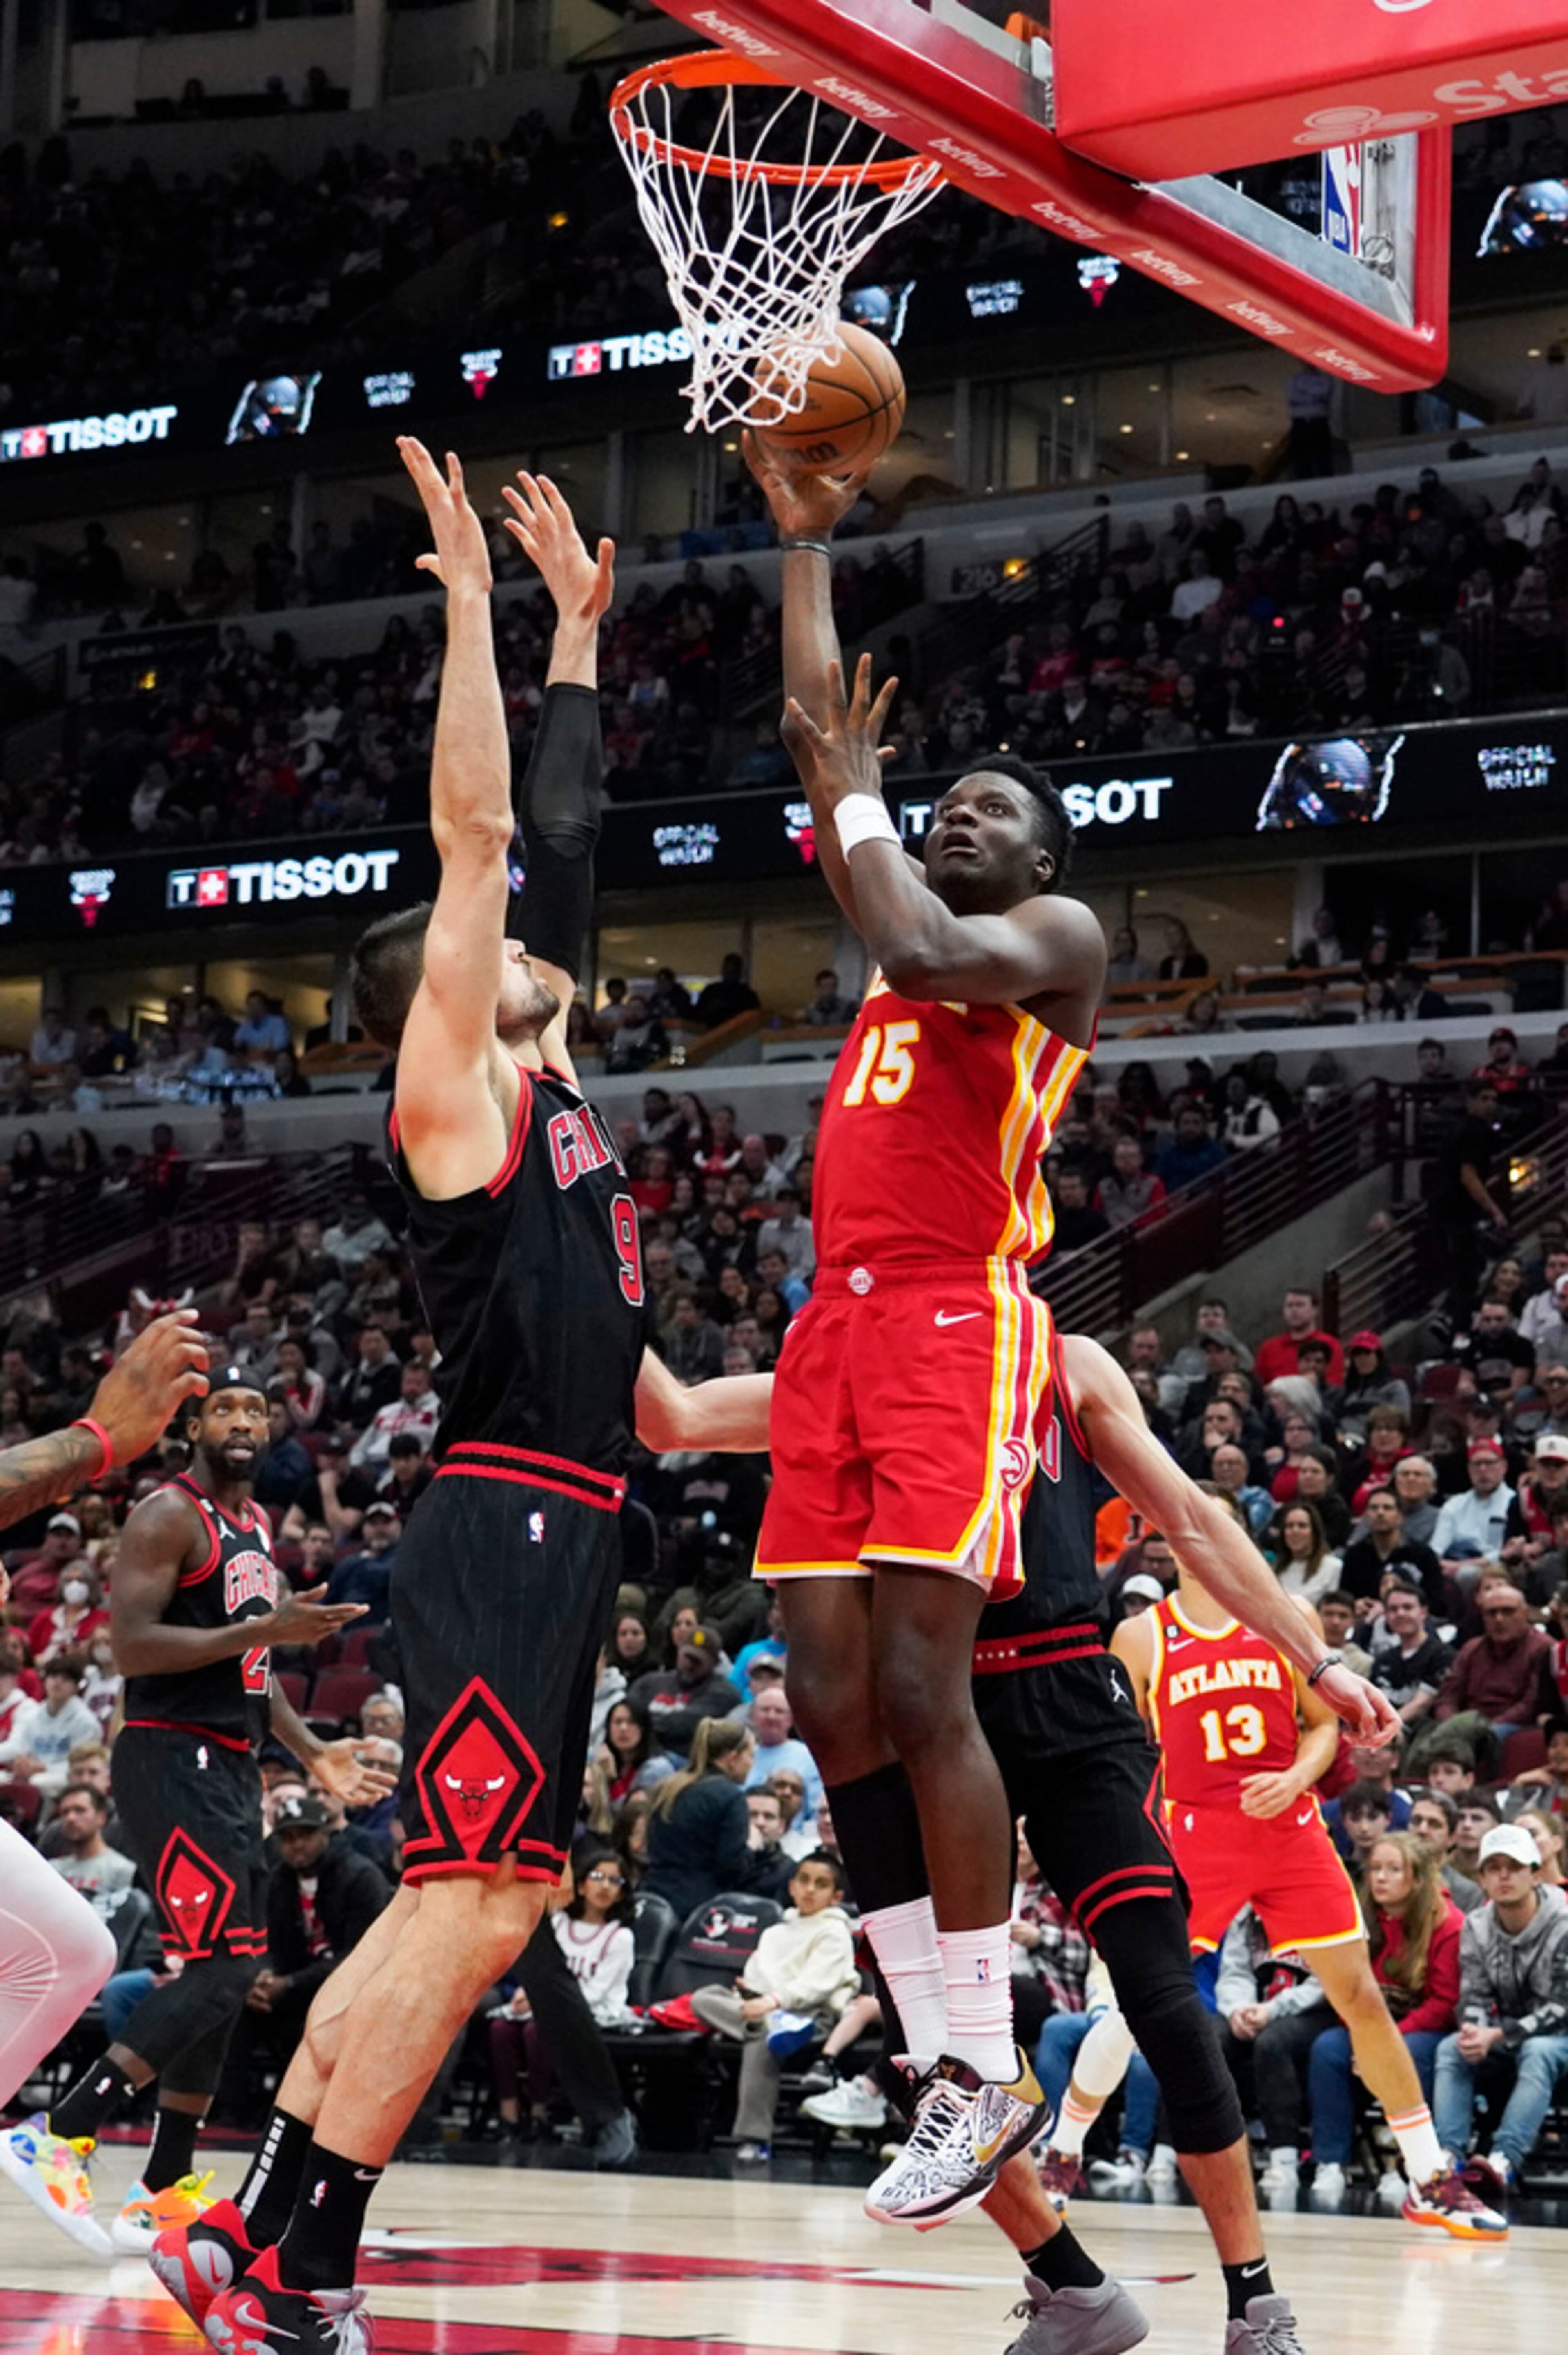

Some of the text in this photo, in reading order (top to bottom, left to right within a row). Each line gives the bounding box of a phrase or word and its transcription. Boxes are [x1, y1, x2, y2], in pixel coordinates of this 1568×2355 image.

[691, 11, 781, 56] betway
[813, 77, 899, 118] betway
[927, 137, 1007, 178] betway
[1031, 201, 1107, 240] betway
[1130, 249, 1203, 286] betway
[1226, 300, 1294, 335] betway
[1314, 348, 1380, 381] betway
[46, 404, 178, 454] TISSOT
[229, 849, 399, 904] TISSOT
[842, 1019, 921, 1107] 15
[610, 1192, 645, 1307] 9
[1168, 1658, 1282, 1706] ATLANTA
[1199, 1703, 1267, 1763] 13
